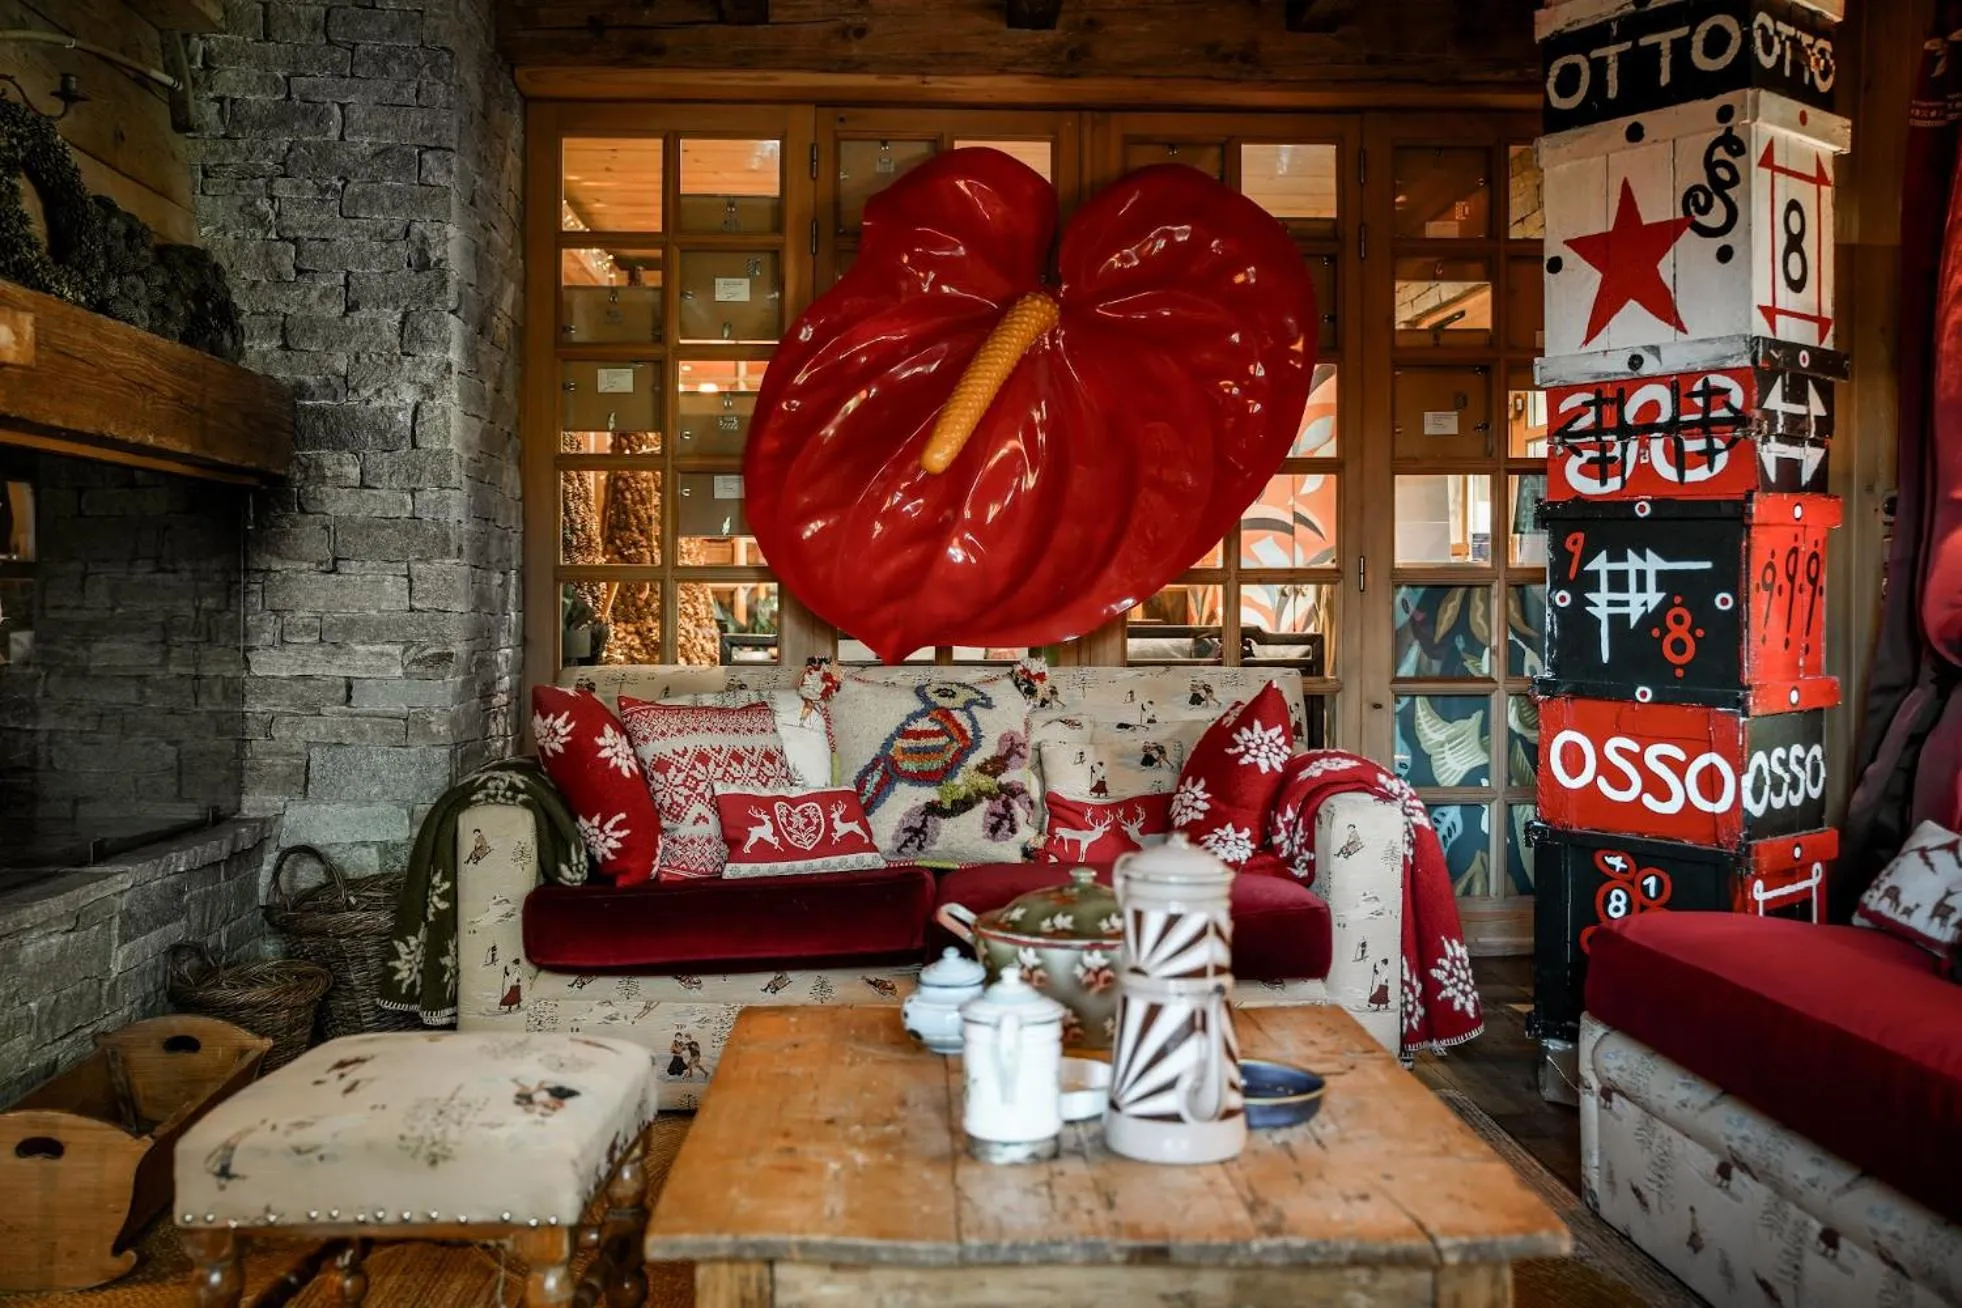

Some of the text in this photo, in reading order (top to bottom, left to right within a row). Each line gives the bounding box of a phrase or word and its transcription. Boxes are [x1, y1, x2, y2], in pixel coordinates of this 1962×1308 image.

[1546, 13, 1742, 110] OTTO
[1753, 11, 1836, 93] OTTO
[1782, 198, 1808, 294] 8
[1564, 532, 1585, 582] 9
[1662, 606, 1696, 665] 8
[1550, 729, 1736, 815] OSSO
[1741, 744, 1826, 817] OSSO
[1607, 888, 1628, 919] 8
[1642, 875, 1657, 899] 1
